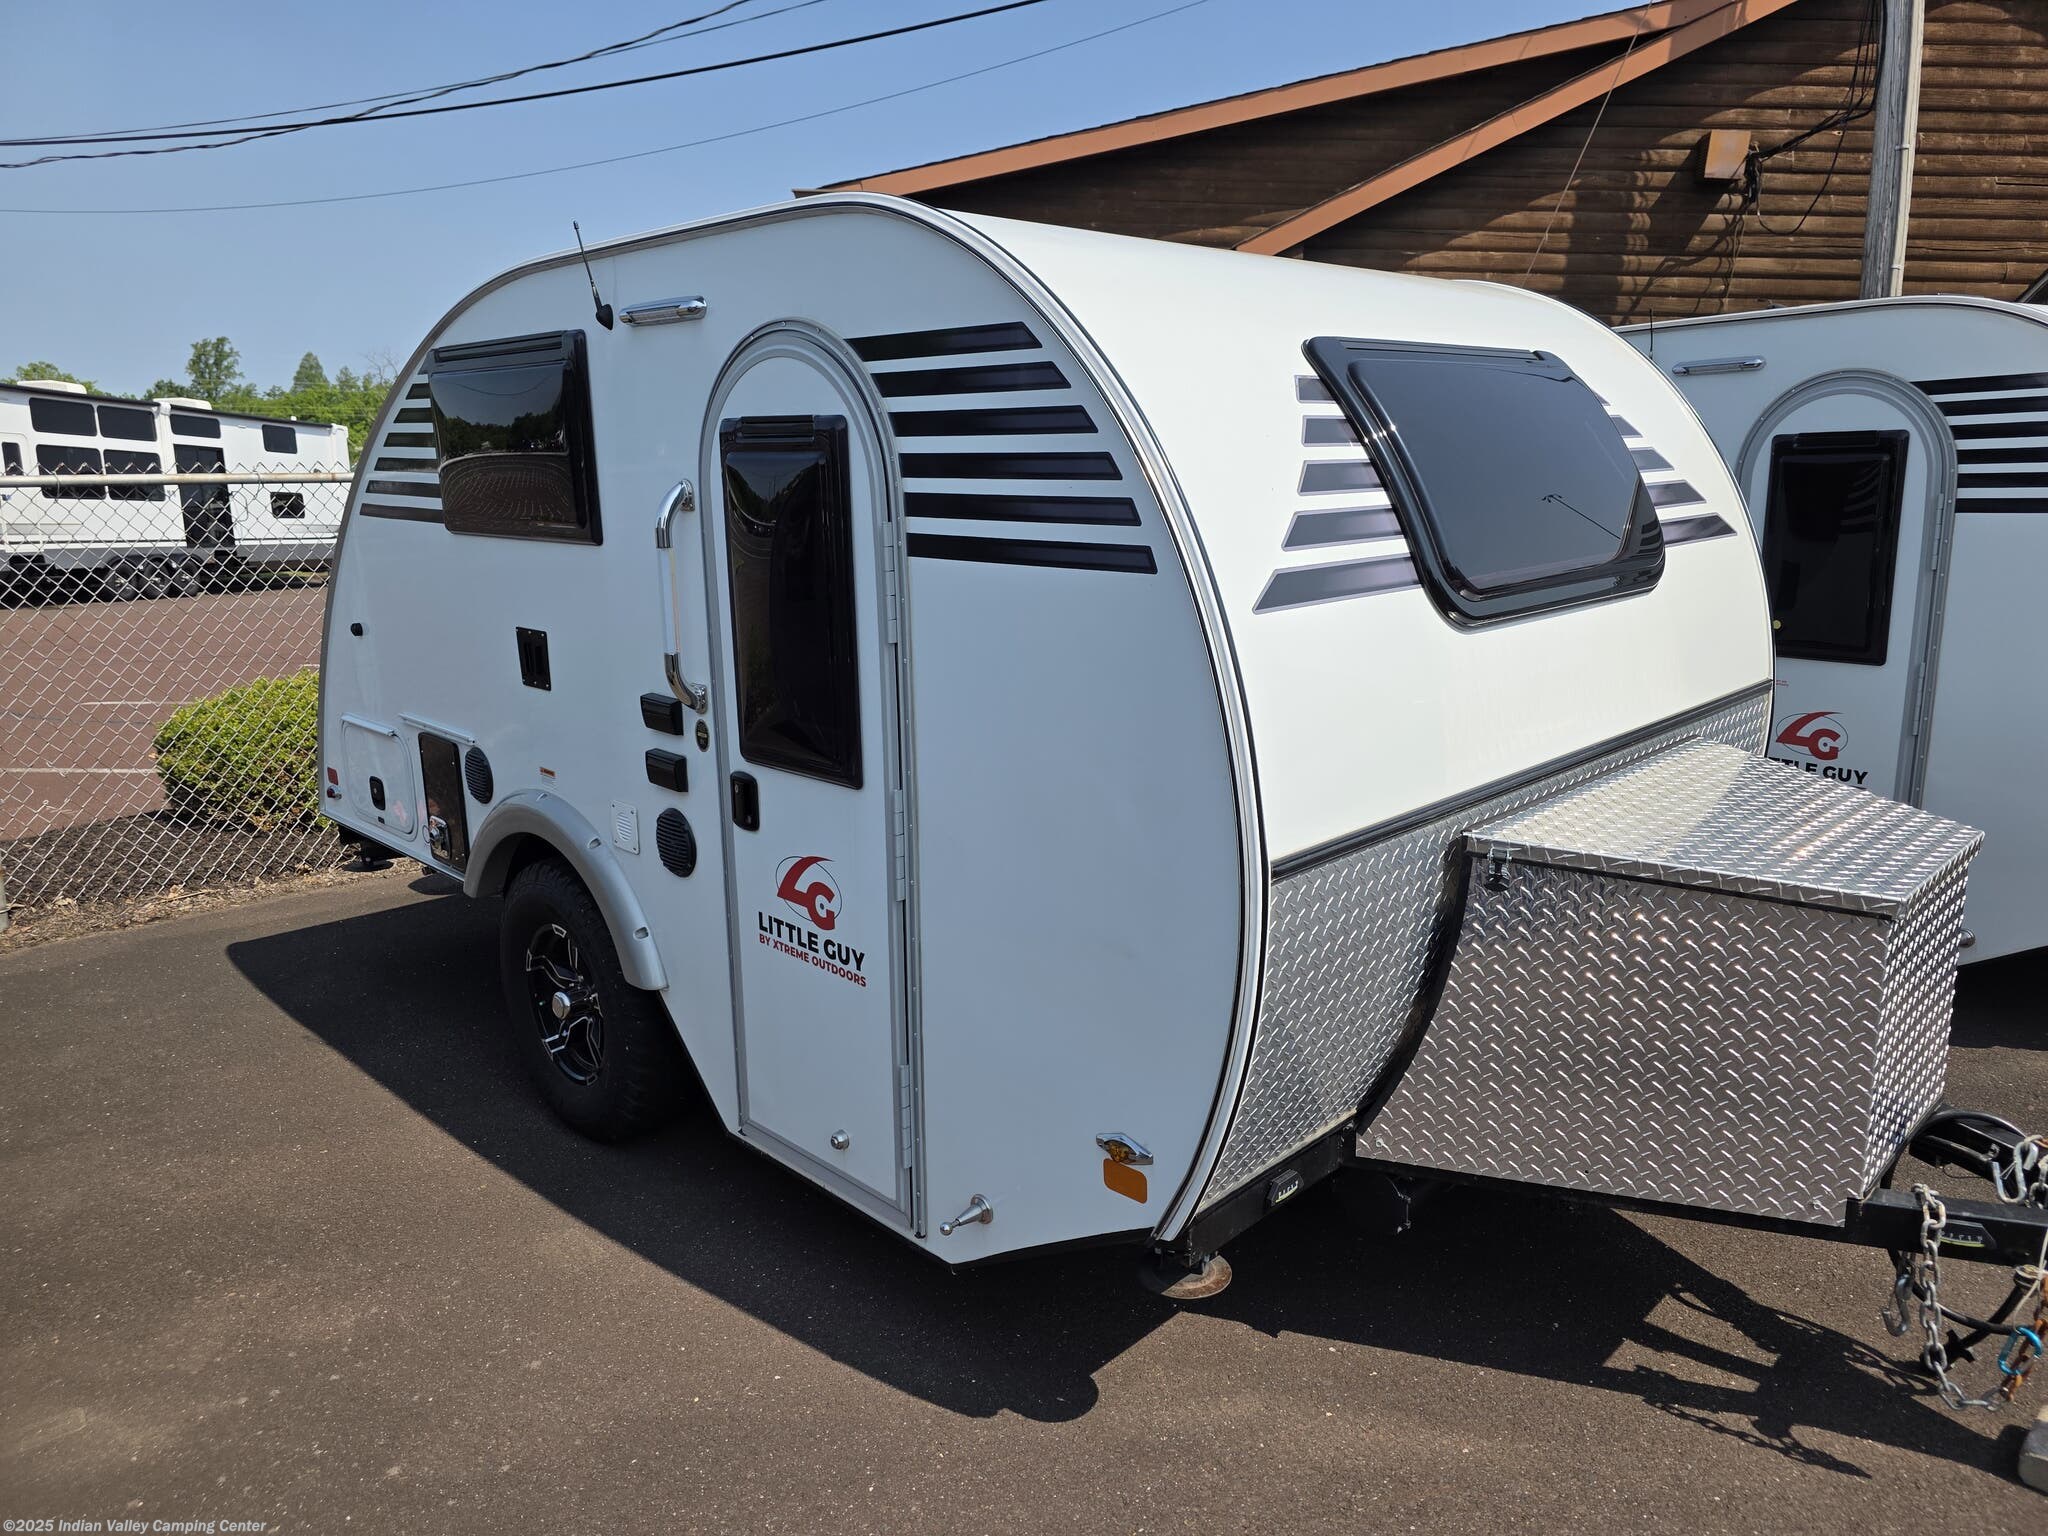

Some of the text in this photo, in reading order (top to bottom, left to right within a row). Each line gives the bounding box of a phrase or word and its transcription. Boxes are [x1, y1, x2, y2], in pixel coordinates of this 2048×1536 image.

[1823, 766, 1868, 785] GUY
[758, 911, 865, 972] LITTLE GUY
[759, 933, 867, 987] BY XTREME OUTDOORS
